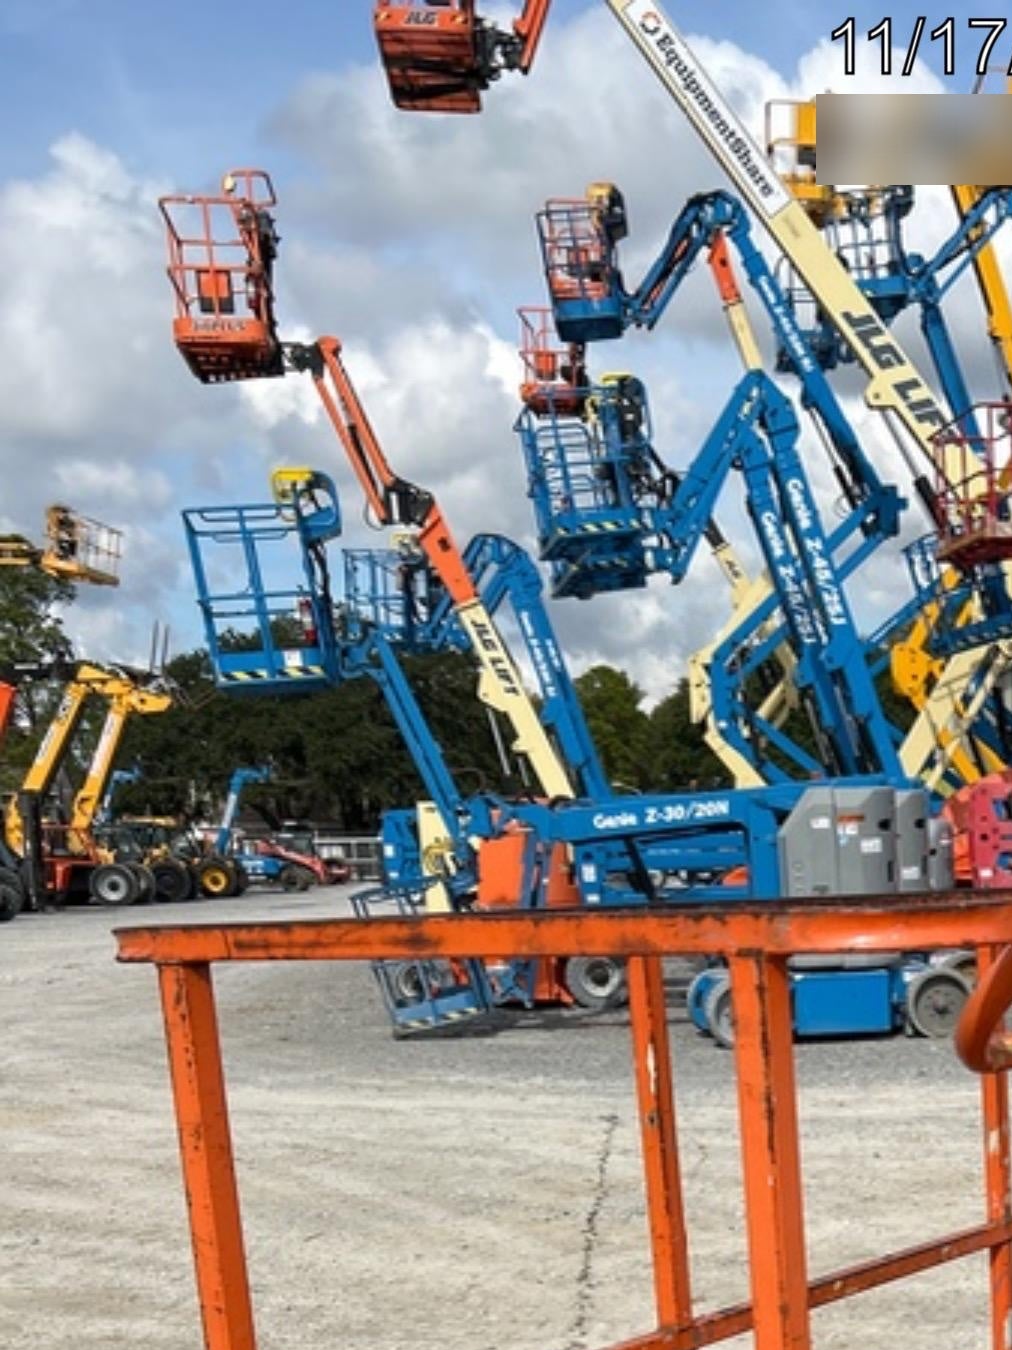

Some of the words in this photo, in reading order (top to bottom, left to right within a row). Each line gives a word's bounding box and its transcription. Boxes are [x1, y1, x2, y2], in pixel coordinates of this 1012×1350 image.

[655, 34, 775, 198] EquipmentShare
[841, 310, 907, 371] JLG
[891, 377, 951, 428] LIF
[470, 618, 499, 652] JLG
[488, 655, 521, 696] LIFT
[592, 812, 638, 830] Genie
[643, 799, 731, 825] Z-30/20N
